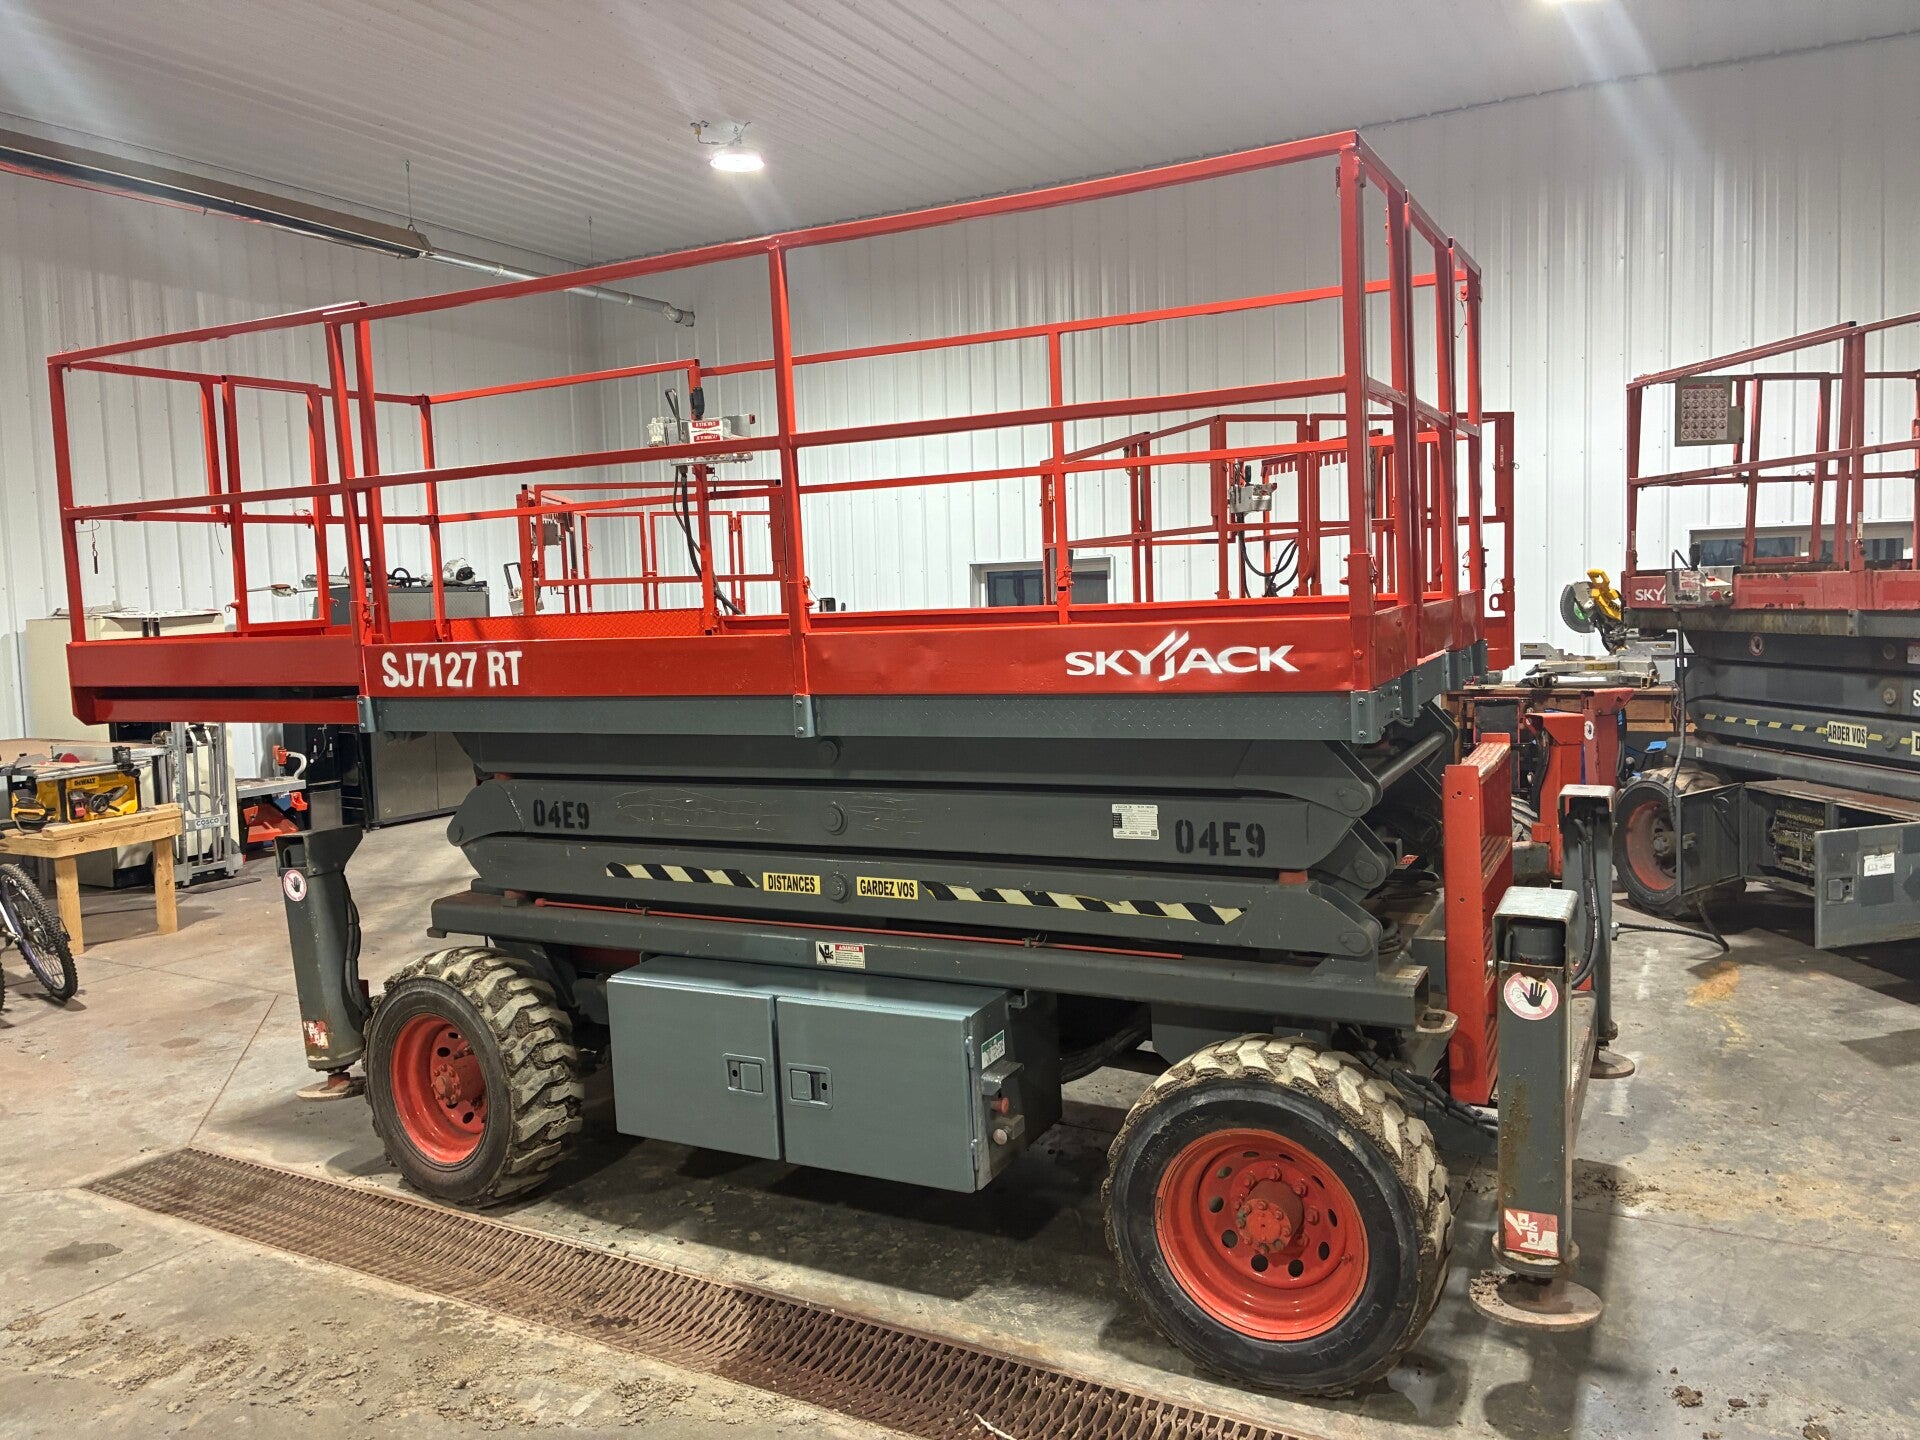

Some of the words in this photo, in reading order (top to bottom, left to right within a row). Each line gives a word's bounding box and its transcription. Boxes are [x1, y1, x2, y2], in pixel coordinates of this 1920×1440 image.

[1065, 630, 1300, 682] SKYJACK
[381, 651, 477, 688] SJ7127
[487, 650, 523, 688] RT
[1851, 727, 1866, 745] VOS
[196, 817, 219, 827] COSCO
[533, 800, 590, 830] 04E9
[1175, 819, 1265, 858] 04E9
[767, 874, 816, 893] DISTANCES
[859, 879, 895, 896] GARDEZ
[896, 881, 916, 898] VOS
